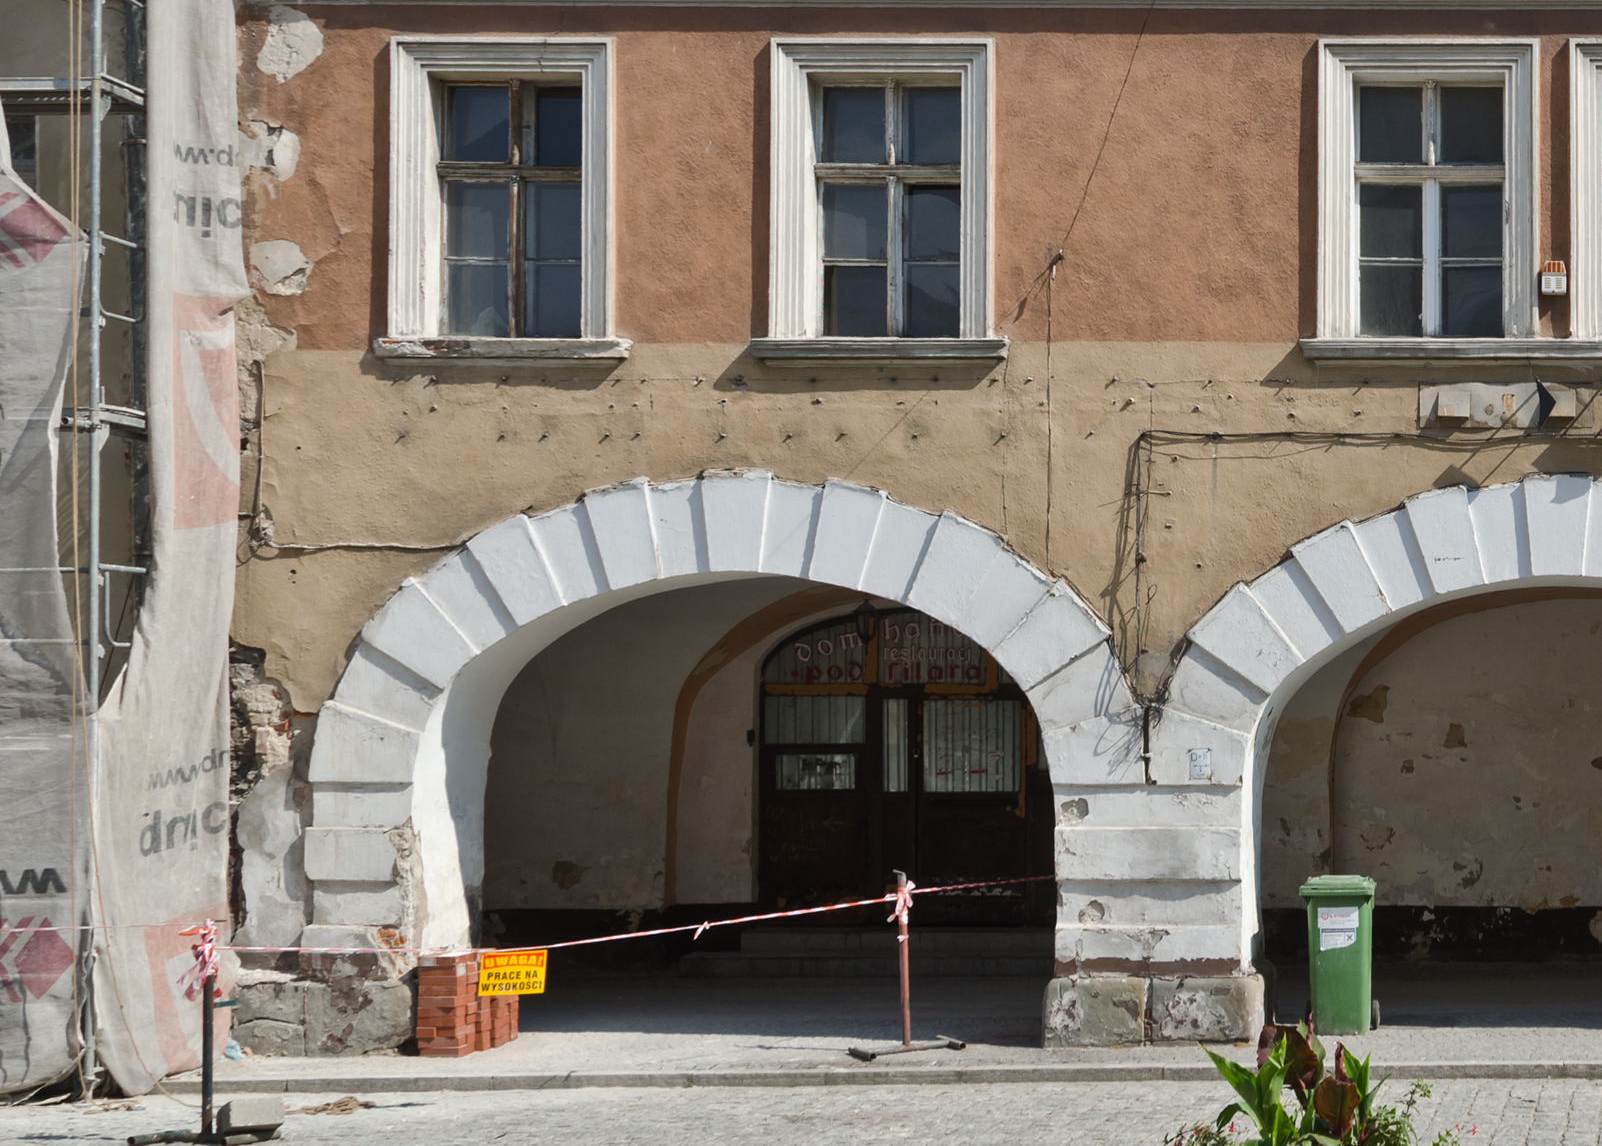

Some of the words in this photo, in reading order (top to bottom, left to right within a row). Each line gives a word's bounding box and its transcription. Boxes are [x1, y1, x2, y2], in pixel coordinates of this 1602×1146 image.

[792, 630, 863, 662] dom
[805, 661, 863, 684] pod
[887, 660, 1014, 682] filara
[485, 955, 544, 968] UWAGA!
[487, 971, 521, 980] PRACE
[525, 970, 538, 979] NA
[481, 979, 542, 992] WYSOKOŚCI
